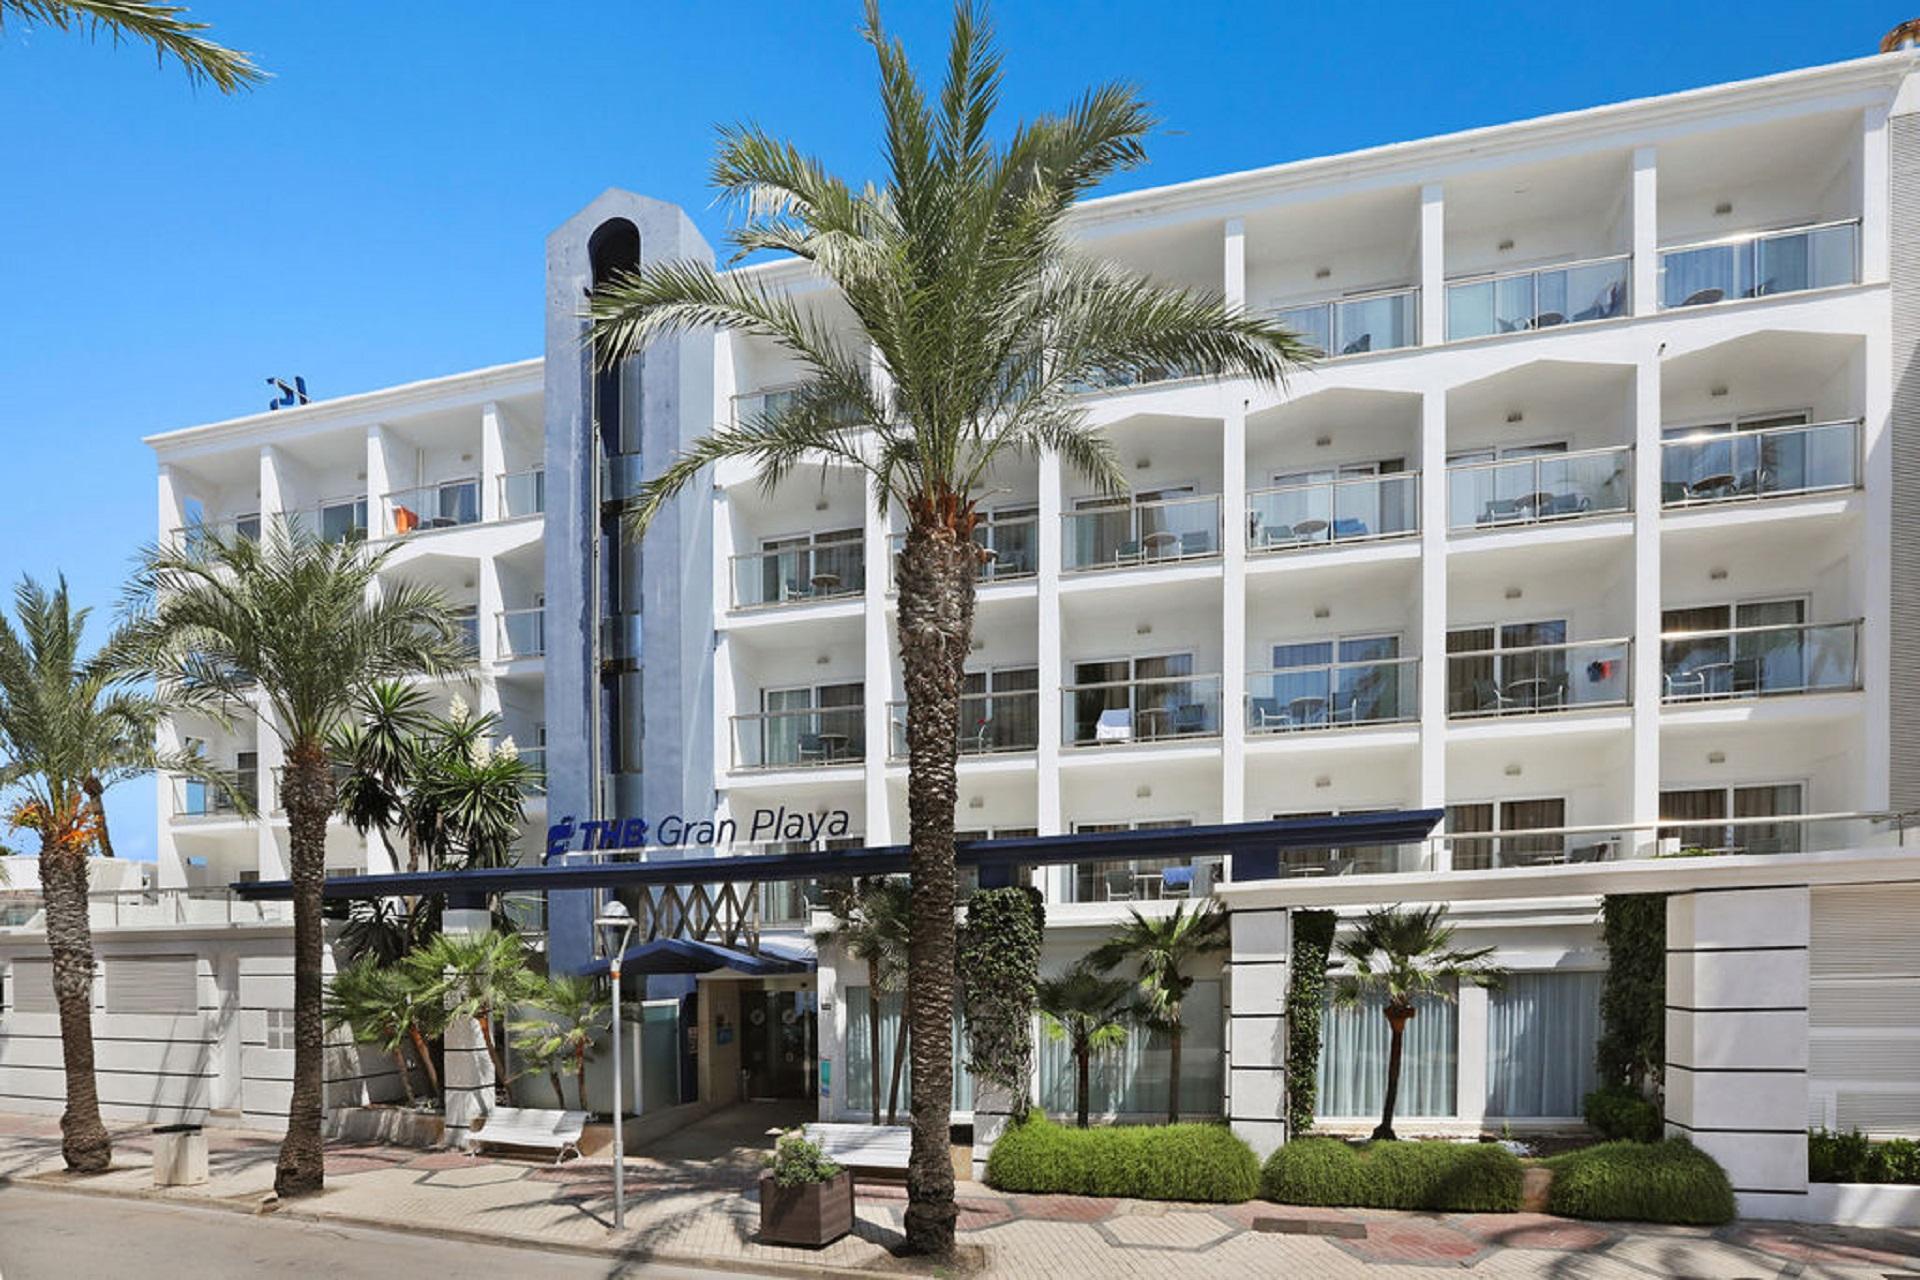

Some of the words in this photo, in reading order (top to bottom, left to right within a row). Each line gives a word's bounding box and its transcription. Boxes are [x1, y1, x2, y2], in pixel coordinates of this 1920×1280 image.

[579, 818, 649, 851] THB
[657, 815, 736, 846] Gran
[750, 806, 849, 843] Playa
